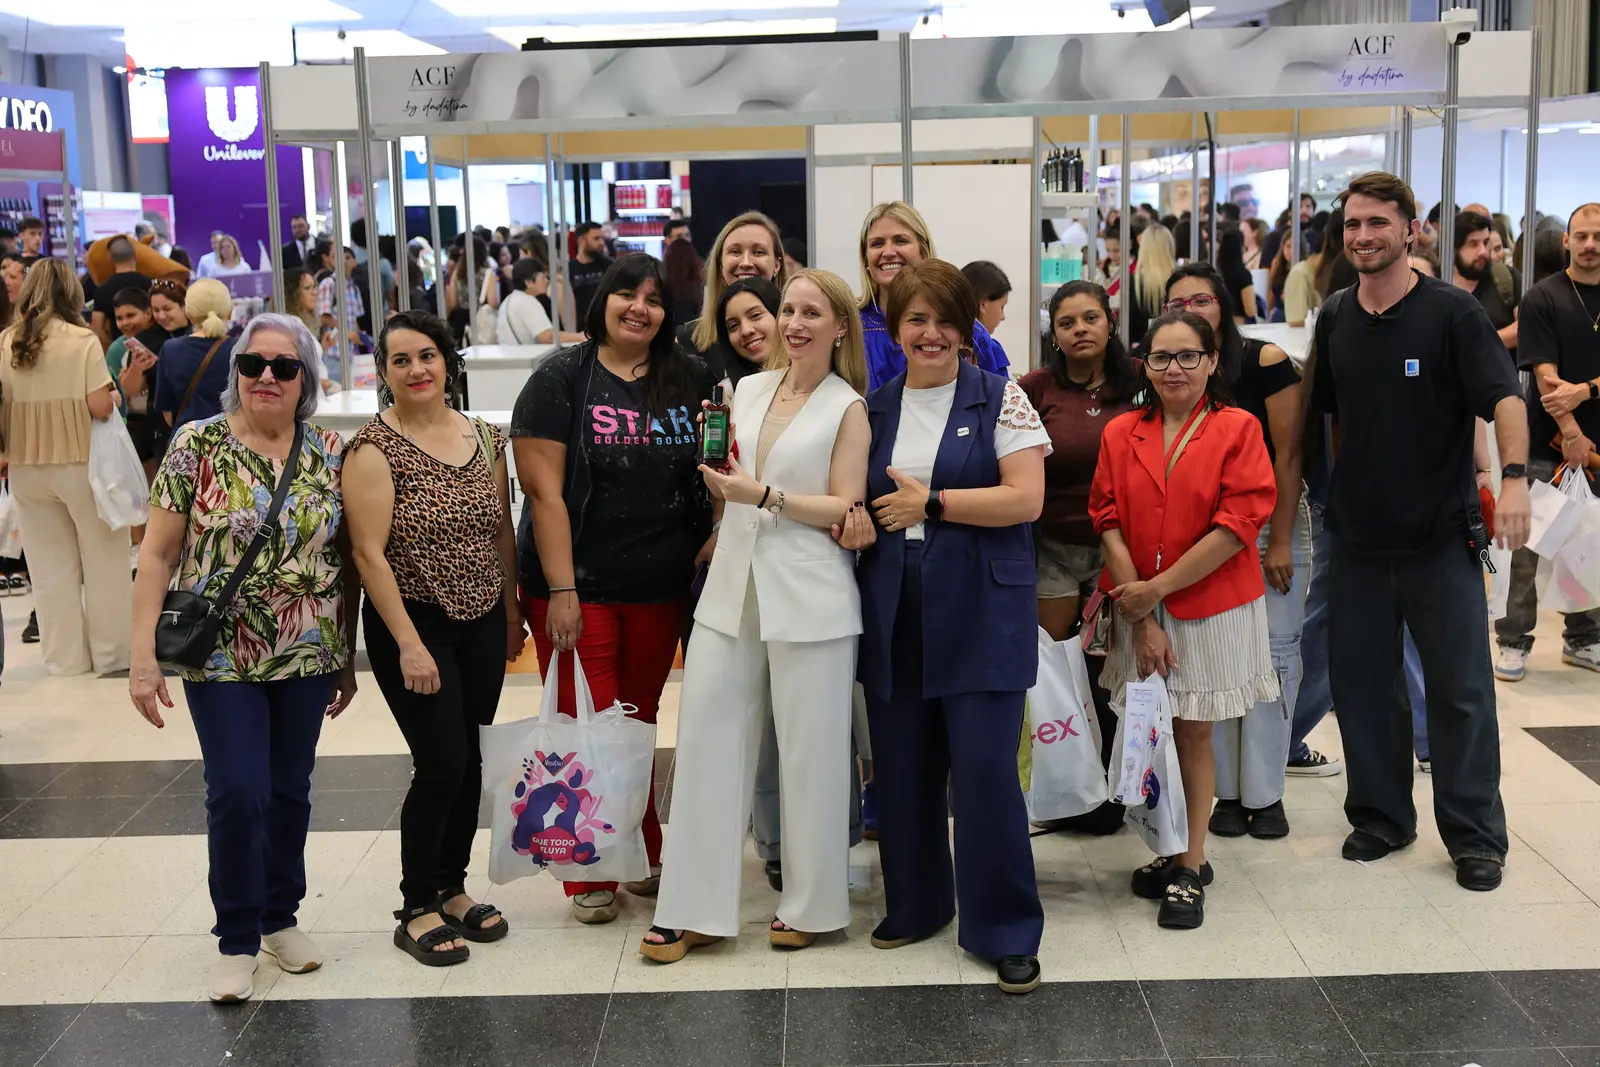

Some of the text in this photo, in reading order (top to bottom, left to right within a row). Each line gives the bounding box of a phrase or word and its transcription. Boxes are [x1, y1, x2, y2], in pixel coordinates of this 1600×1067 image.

[1348, 34, 1395, 55] ACF
[410, 66, 456, 86] ACF
[1338, 69, 1353, 87] by
[402, 100, 418, 118] by
[592, 405, 695, 436] STAR
[550, 838, 576, 848] TODO
